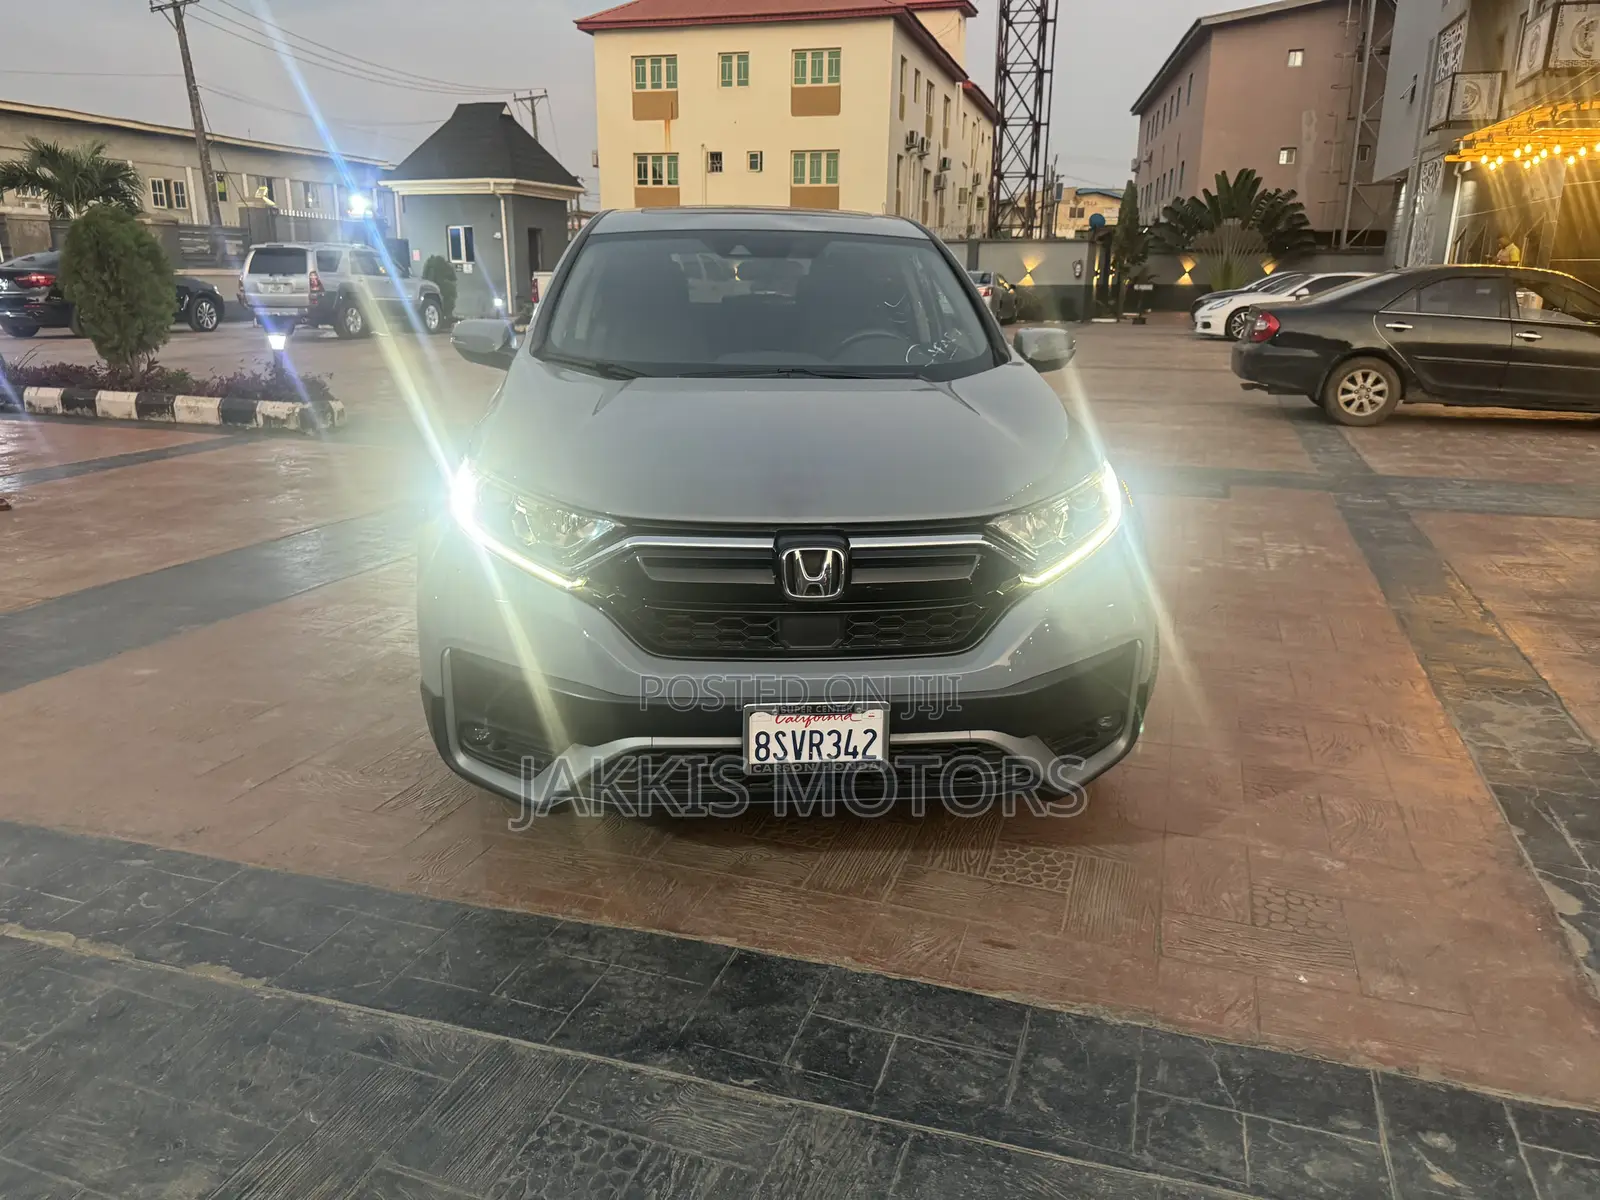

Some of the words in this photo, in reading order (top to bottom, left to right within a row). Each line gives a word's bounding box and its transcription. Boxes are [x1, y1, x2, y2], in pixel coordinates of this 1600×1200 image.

[780, 705, 812, 714] SUPER
[816, 704, 851, 714] CENTER
[754, 728, 878, 762] 8SVR342
[753, 763, 815, 774] CARSON
[823, 761, 880, 772] HONDA
